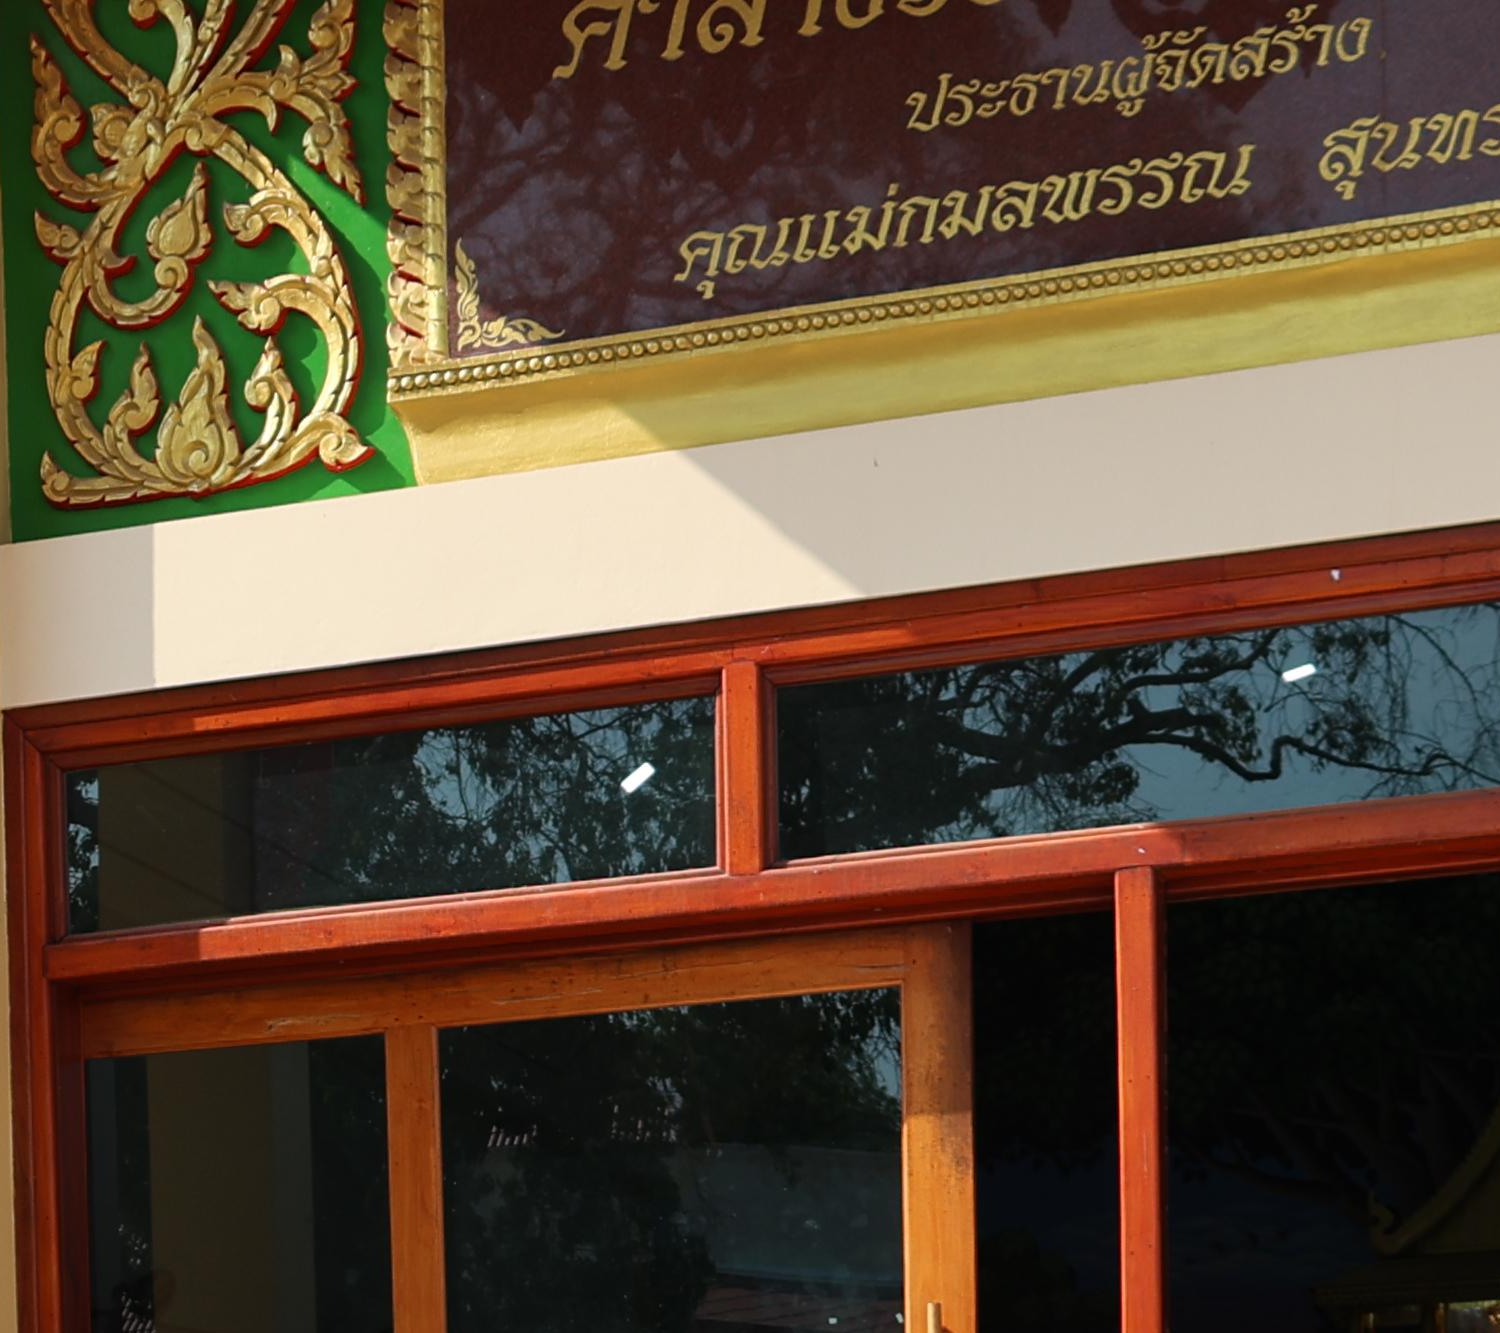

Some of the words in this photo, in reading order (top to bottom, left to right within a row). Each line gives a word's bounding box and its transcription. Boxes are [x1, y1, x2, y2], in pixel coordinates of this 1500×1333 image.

[905, 3, 1373, 132] ประธานผู้จัดสร้าง
[674, 143, 1257, 300] คุณแม่กมลพรรณ
